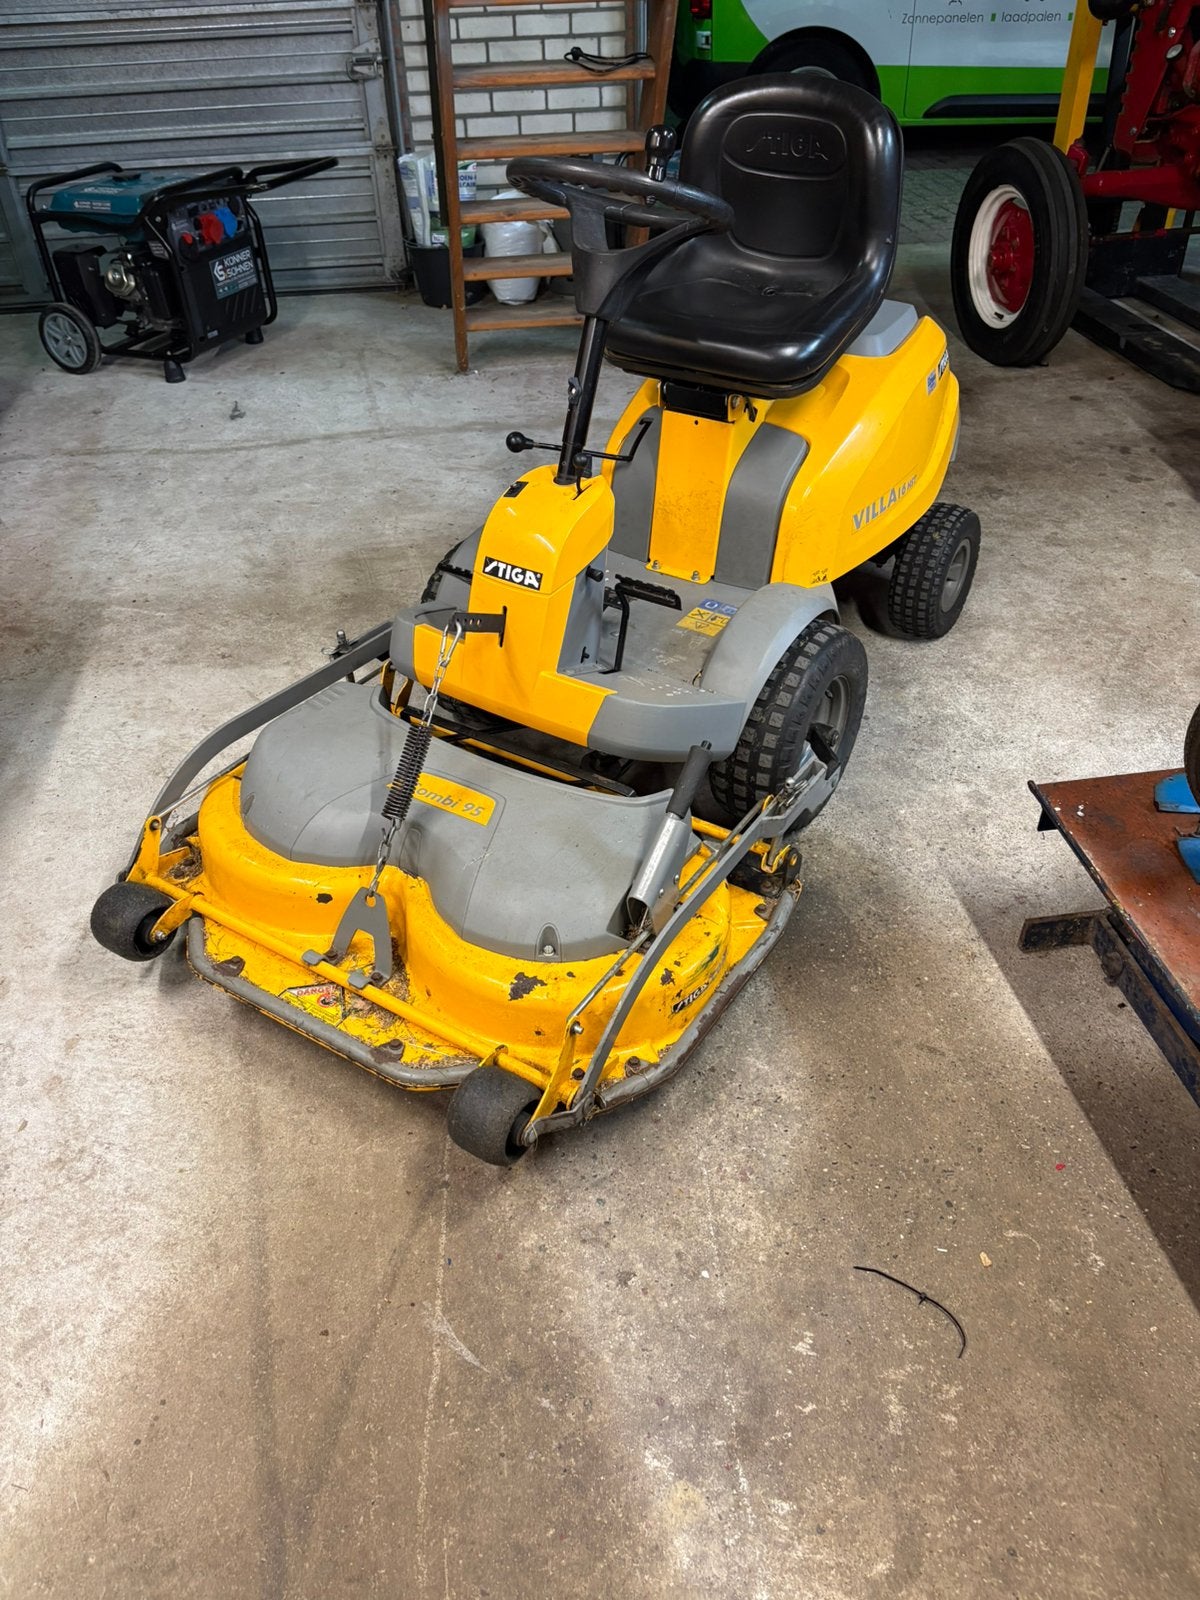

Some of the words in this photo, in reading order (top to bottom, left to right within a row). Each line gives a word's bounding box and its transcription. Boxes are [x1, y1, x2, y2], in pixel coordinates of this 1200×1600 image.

[901, 13, 985, 25] Zonnepanelen
[1001, 11, 1062, 23] laadpalen
[746, 132, 829, 161] STIGA
[853, 487, 897, 530] VILLA
[484, 560, 540, 589] STIGA
[413, 782, 461, 808] ombi
[462, 802, 485, 817] 95
